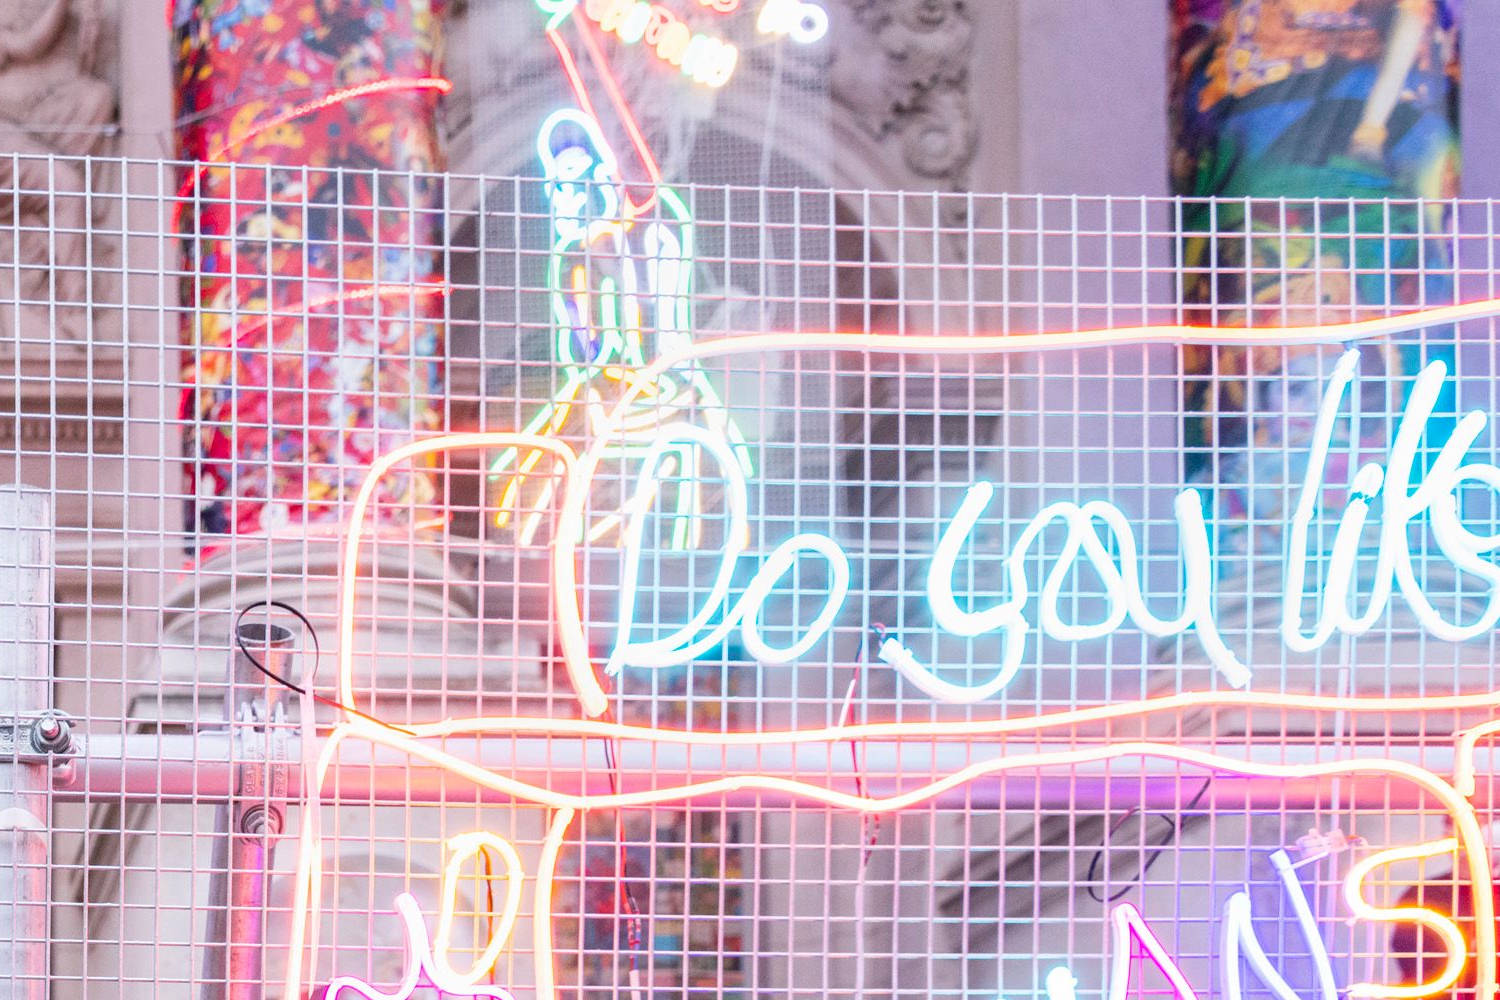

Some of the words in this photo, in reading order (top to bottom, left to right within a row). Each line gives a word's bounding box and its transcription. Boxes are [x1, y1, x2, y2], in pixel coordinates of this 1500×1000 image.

[603, 422, 850, 676] Do
[877, 480, 1252, 705] you
[1282, 347, 1500, 653] like
